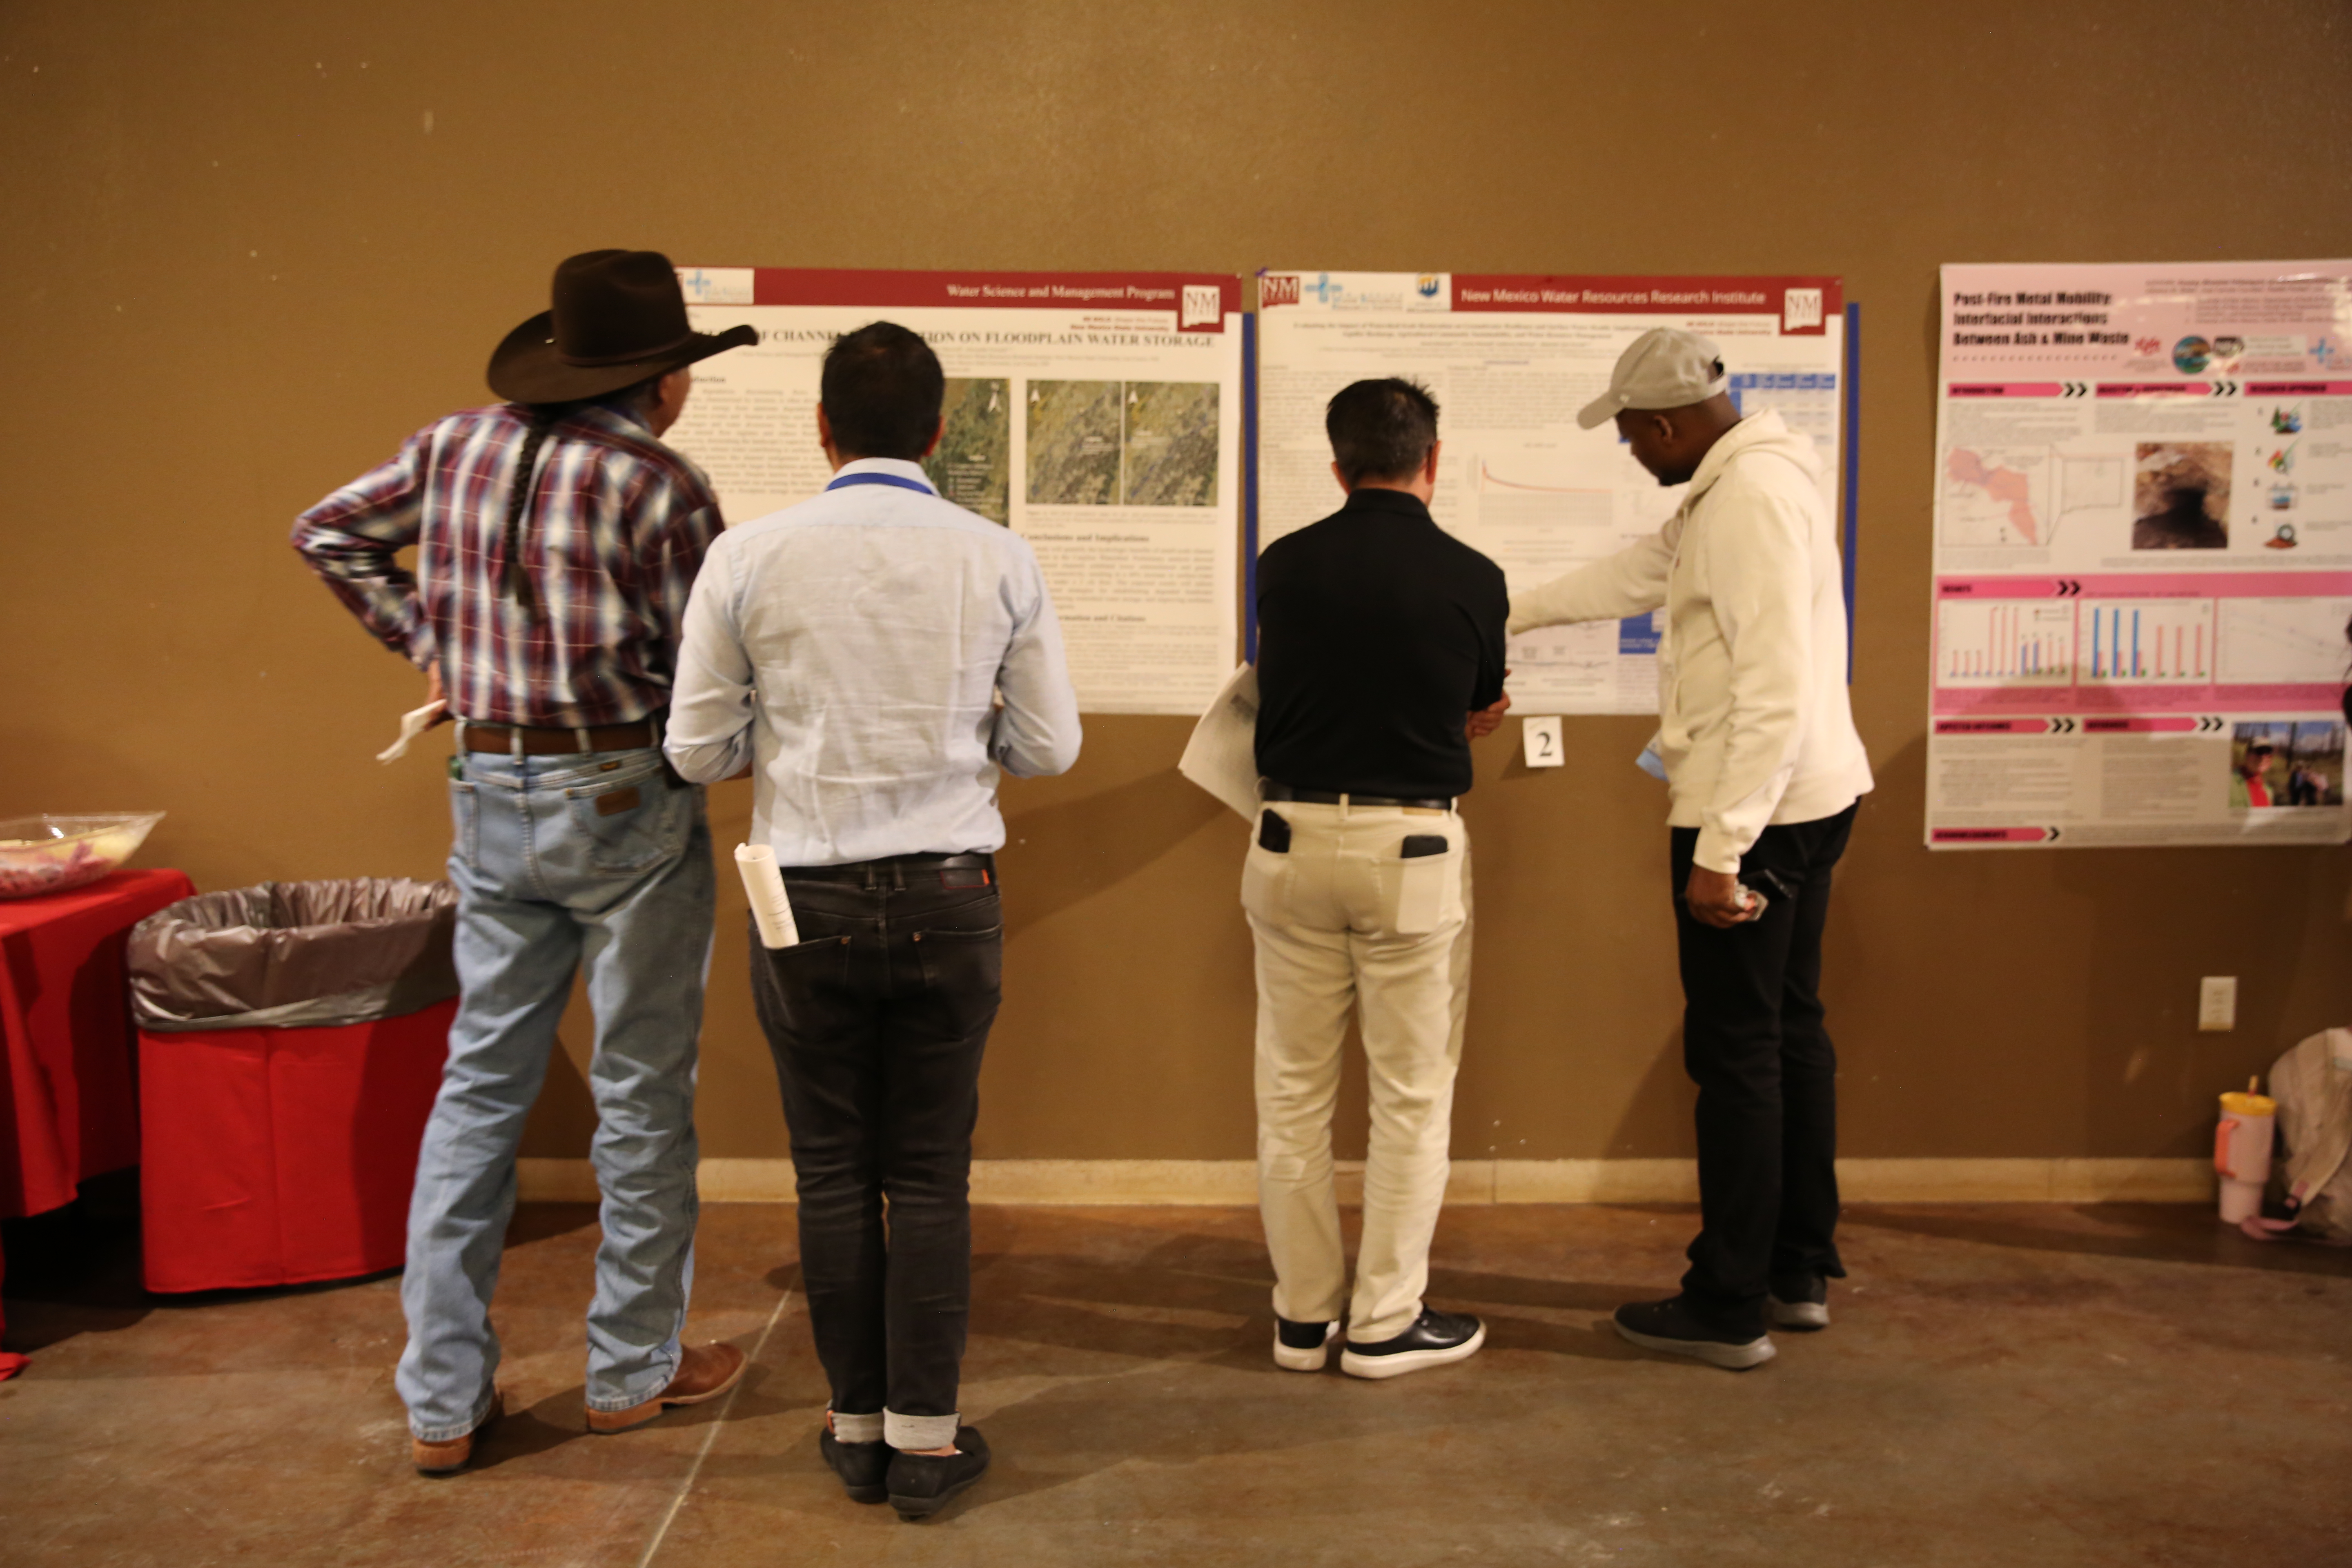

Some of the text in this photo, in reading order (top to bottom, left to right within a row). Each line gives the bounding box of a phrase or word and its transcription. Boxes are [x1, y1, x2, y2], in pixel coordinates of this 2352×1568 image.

[1263, 278, 1298, 292] NM
[947, 285, 1175, 302] Water Science and Management Program
[1185, 292, 1217, 309] NM
[1461, 289, 1767, 305] New Mexico Water Resources Research Institute
[2015, 292, 2052, 306] Metal
[1787, 296, 1820, 312] NM
[1954, 313, 2107, 325] Interfacial Interactions
[960, 331, 982, 344] ON
[984, 332, 1083, 347] FLOODPLAIN
[1087, 333, 1140, 347] WATER
[1143, 334, 1215, 348] STORAGE
[1953, 332, 2010, 345] Between
[2013, 332, 2037, 345] Ash
[2053, 332, 2084, 345] Mine
[2088, 332, 2130, 345] Waste
[1535, 731, 1552, 757] 2
